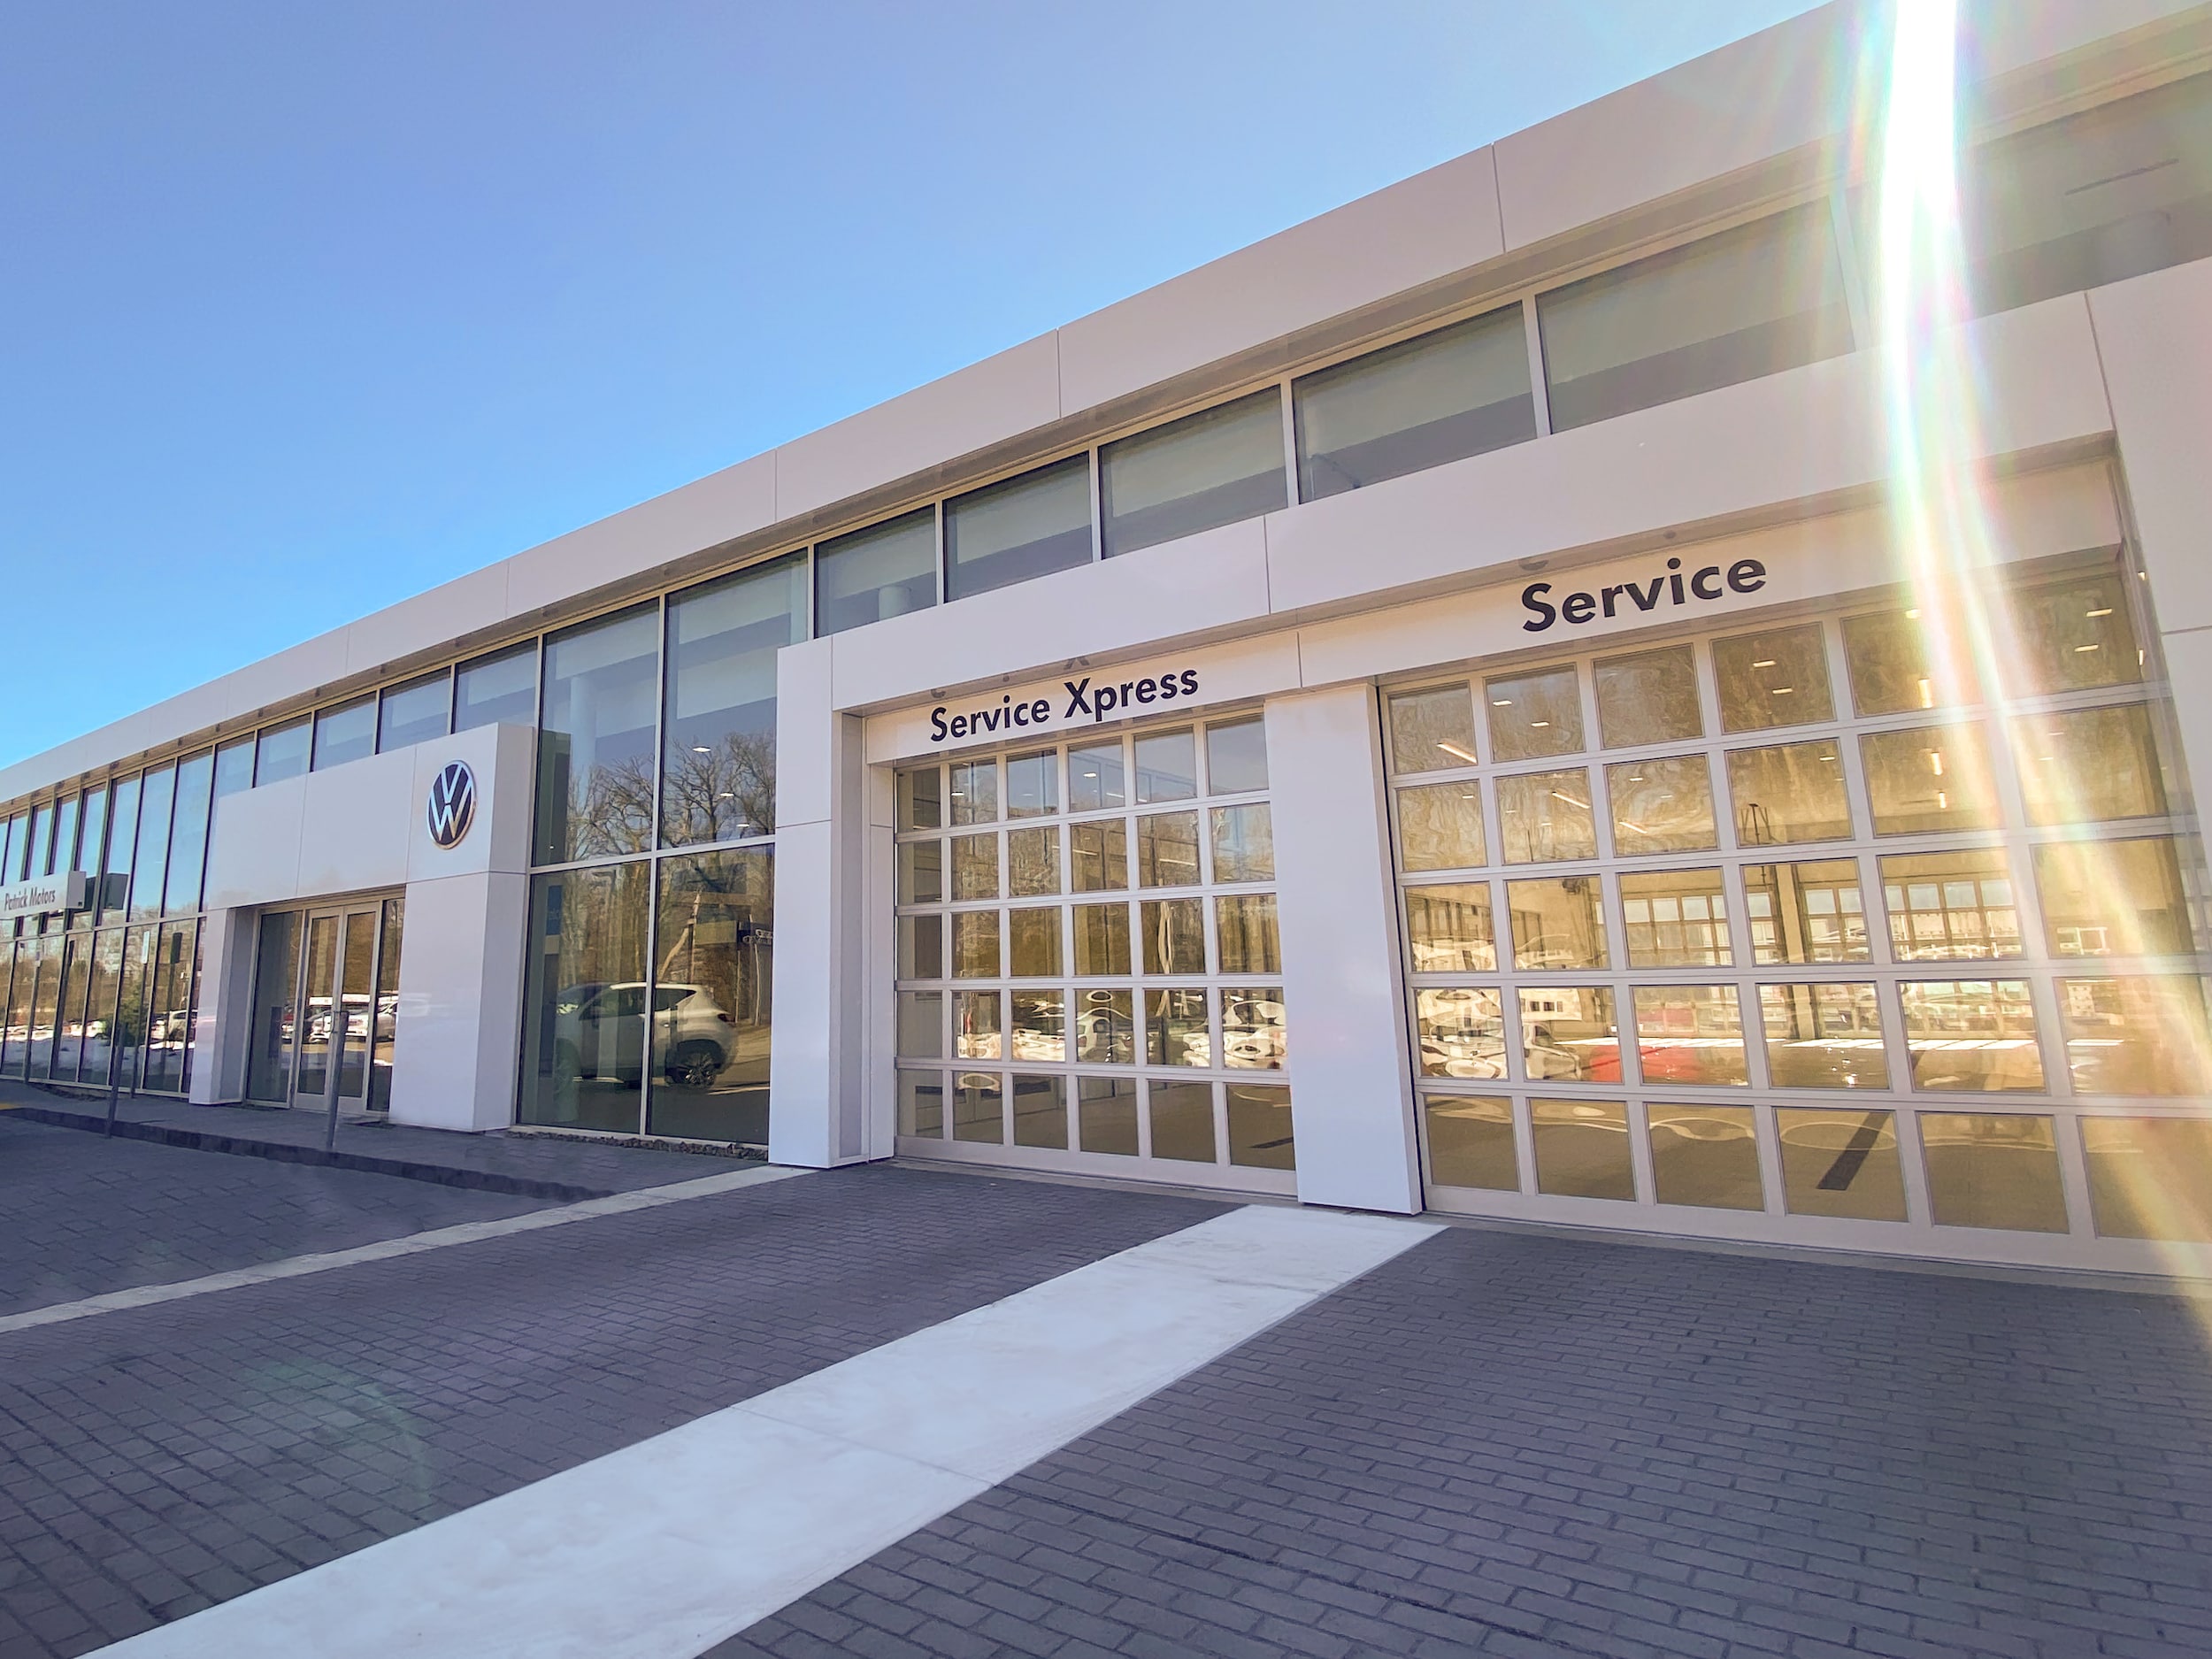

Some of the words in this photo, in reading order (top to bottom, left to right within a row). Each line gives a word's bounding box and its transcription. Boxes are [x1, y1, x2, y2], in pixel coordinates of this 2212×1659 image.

[1521, 557, 1766, 632] Service
[930, 695, 1051, 742] Service
[1064, 669, 1199, 723] Xpress
[4, 887, 28, 911] Patrick
[29, 887, 56, 906] Motors
